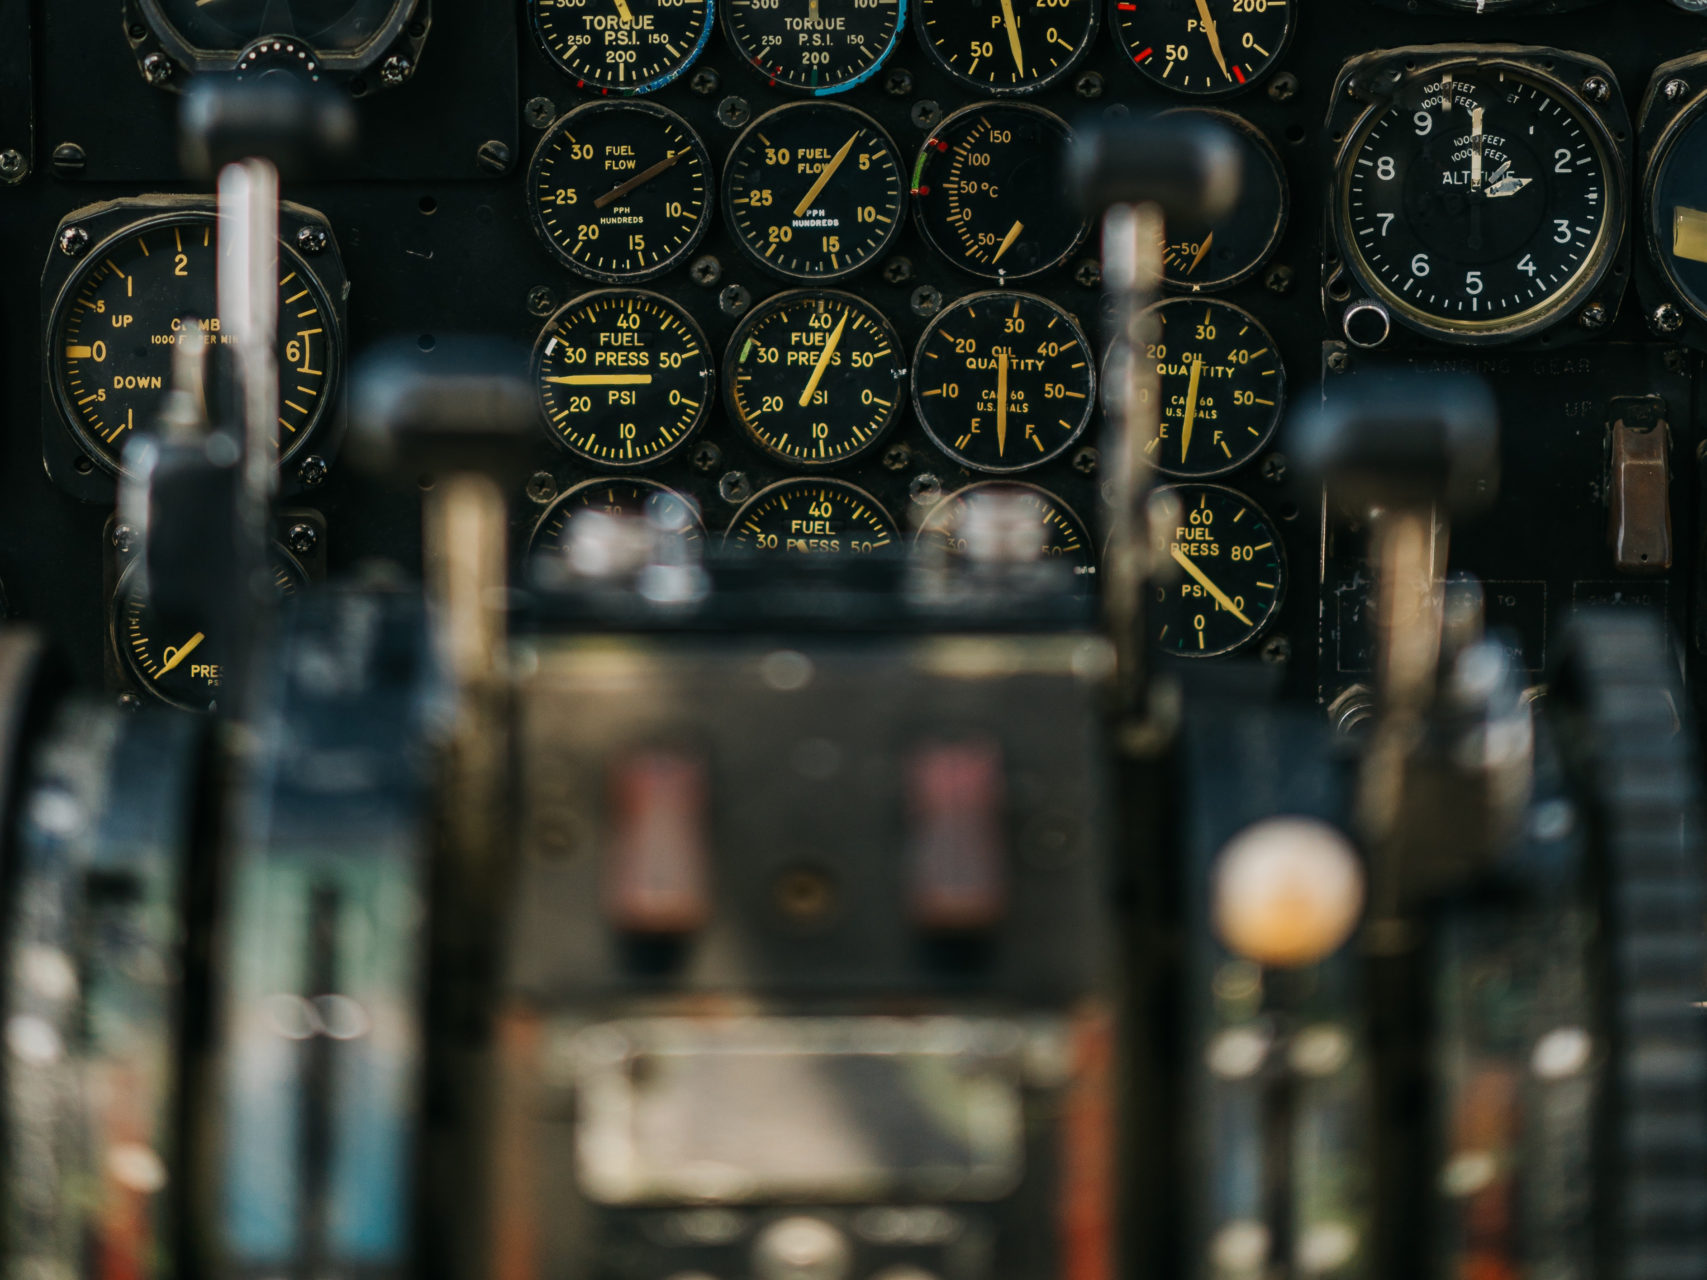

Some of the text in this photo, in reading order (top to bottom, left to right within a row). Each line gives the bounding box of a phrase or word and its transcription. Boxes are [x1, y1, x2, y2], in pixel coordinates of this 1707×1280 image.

[606, 51, 637, 63] 200
[802, 52, 830, 64] 200
[1452, 82, 1476, 94] FEET
[1413, 111, 1433, 136] 9
[989, 130, 1012, 144] 150
[1482, 134, 1506, 146] FEET
[571, 144, 594, 160] 30
[605, 146, 635, 156] FUEL
[765, 148, 790, 166] 30
[797, 148, 832, 158] FUEL
[605, 160, 636, 170] FLOW
[968, 153, 990, 167] 100
[960, 181, 978, 194] 50
[556, 189, 578, 205] 25
[750, 189, 773, 207] 25
[600, 216, 644, 224] HUNDREDS
[578, 224, 599, 240] 20
[768, 226, 792, 243] 20
[1517, 253, 1538, 277] 4
[111, 315, 133, 328] UP
[617, 313, 640, 330] 40
[809, 313, 832, 329] 40
[1004, 318, 1025, 334] 30
[600, 332, 645, 346] FUEL
[92, 340, 107, 362] 0
[286, 340, 301, 362] 6
[564, 348, 587, 364] 30
[757, 348, 779, 364] 30
[1037, 341, 1059, 357] 40
[595, 352, 650, 366] PRESS
[659, 353, 682, 369] 50
[851, 352, 874, 368] 50
[966, 357, 1045, 372] QUATITY
[1227, 349, 1249, 365] 40
[1156, 364, 1236, 379] QUATITY
[114, 376, 162, 389] DOWN
[608, 390, 636, 405] PSI
[982, 389, 998, 399] CA
[1044, 383, 1065, 399] 50
[1233, 390, 1254, 406] 50
[1171, 395, 1188, 405] CA
[971, 418, 981, 433] E
[1025, 424, 1035, 439] F
[1160, 423, 1169, 438] E
[1214, 430, 1223, 445] F
[809, 501, 832, 518] 40
[1189, 509, 1213, 525] 60
[791, 520, 836, 535] FUEL
[1176, 527, 1214, 541] FUEL
[756, 534, 778, 550] 30
[1231, 546, 1254, 561] 80
